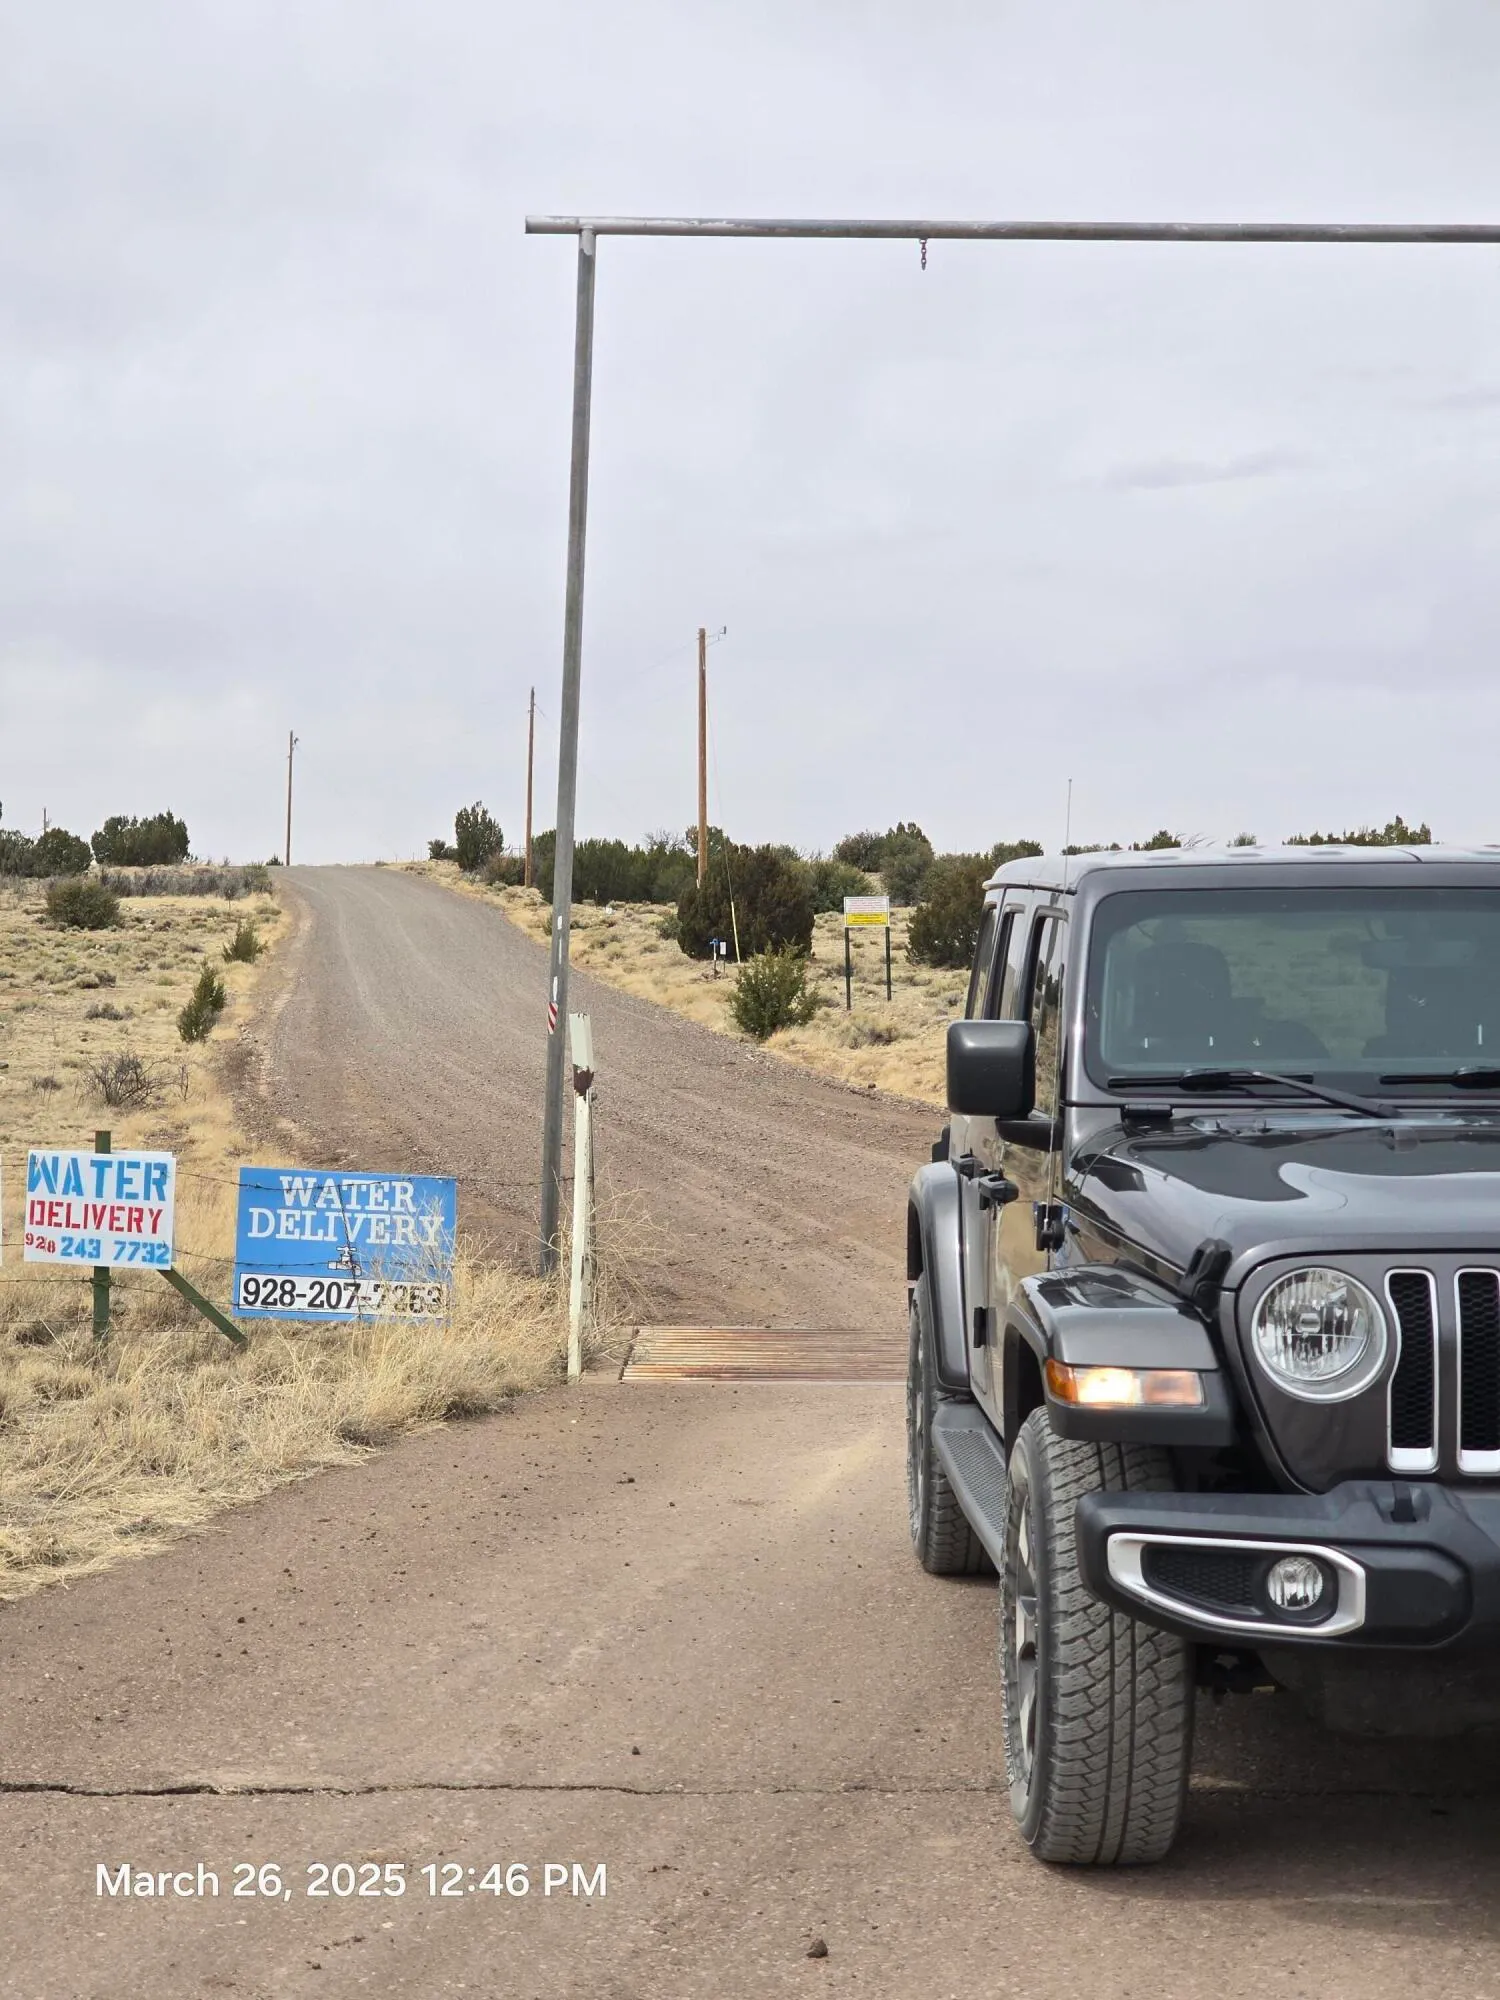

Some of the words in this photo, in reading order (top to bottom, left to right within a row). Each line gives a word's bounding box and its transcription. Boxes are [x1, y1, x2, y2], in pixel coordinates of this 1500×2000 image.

[28, 1153, 168, 1201] WATER
[280, 1176, 416, 1212] WATER
[29, 1200, 163, 1234] DELIVERY
[248, 1208, 445, 1246] DELIVERY
[25, 1232, 56, 1254] 928
[60, 1236, 102, 1259] 243
[113, 1240, 170, 1264] 7732
